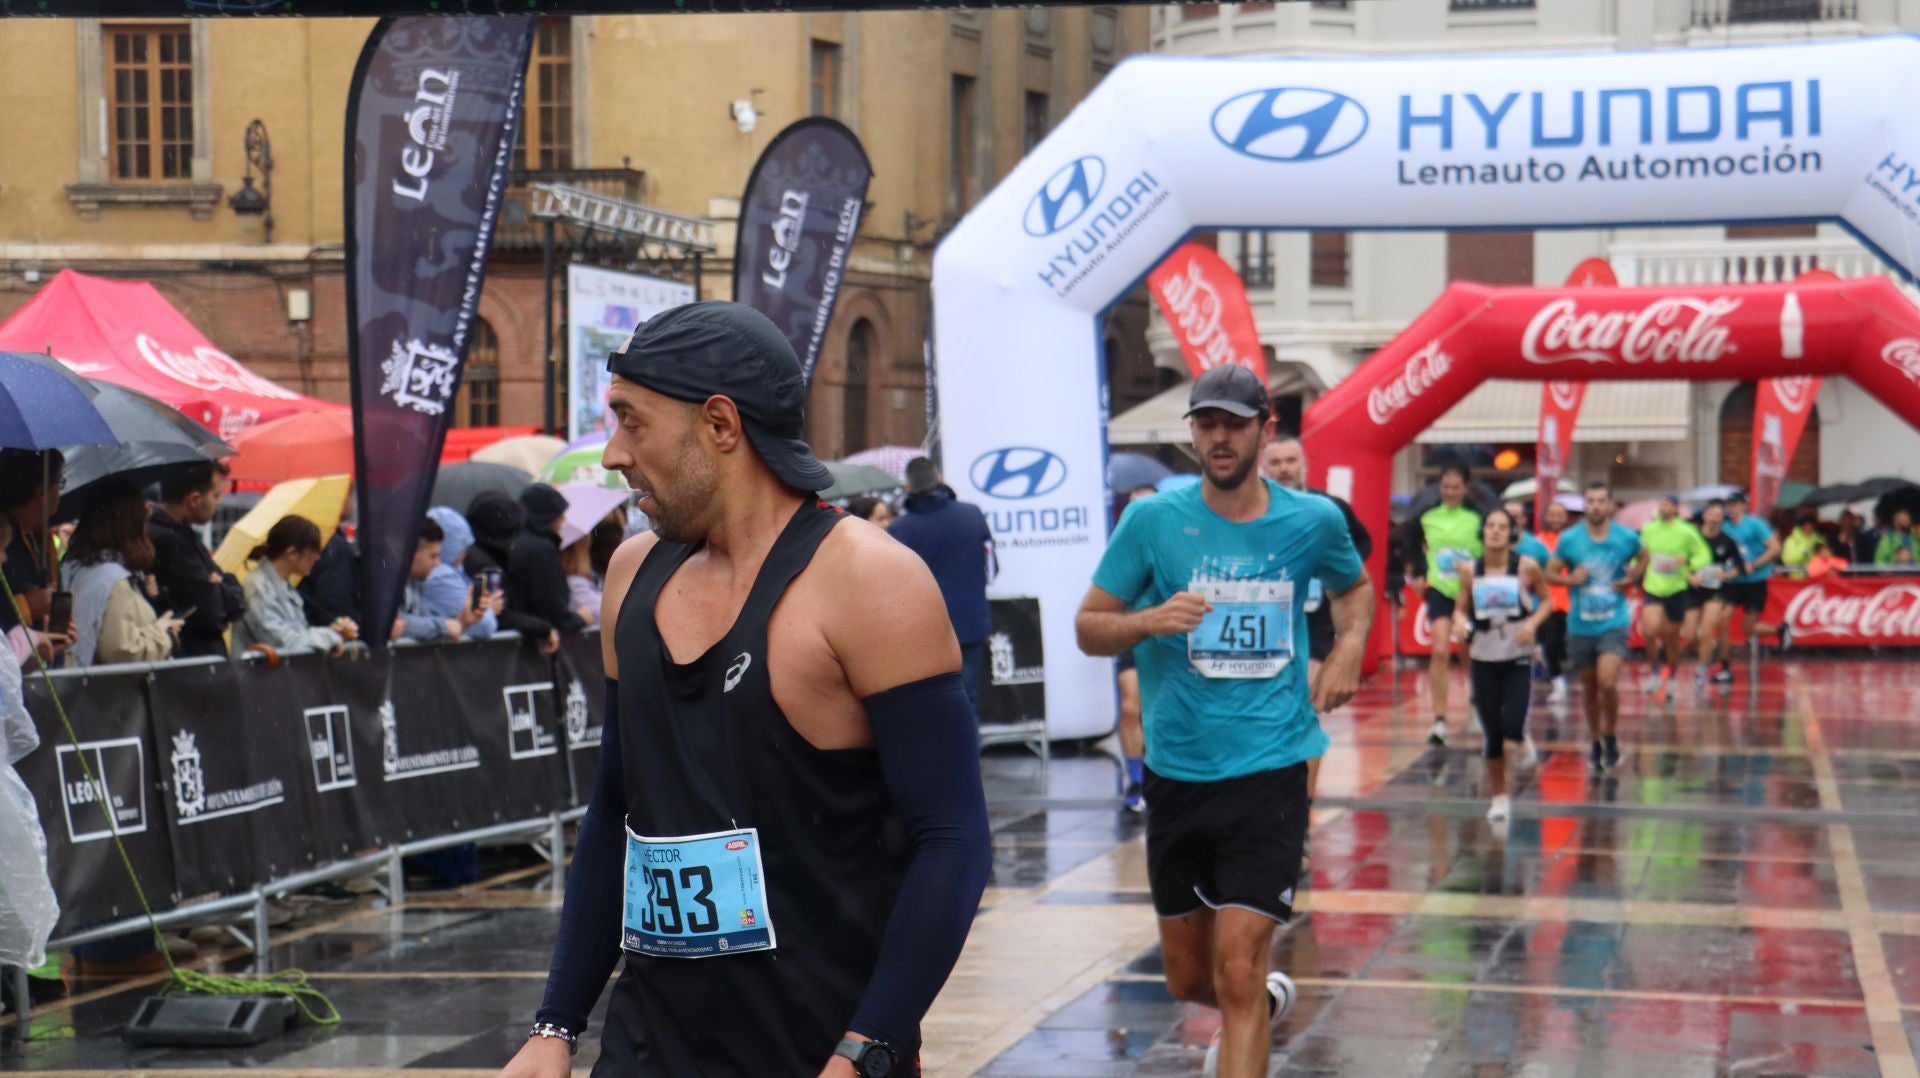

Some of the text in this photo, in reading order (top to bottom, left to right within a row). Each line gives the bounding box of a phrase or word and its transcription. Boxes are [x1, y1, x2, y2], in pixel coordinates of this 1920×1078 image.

[1399, 78, 1820, 151] HYUNDAI
[1398, 145, 1822, 185] Lemauto Automoción
[836, 197, 857, 242] LEÓN
[1037, 170, 1159, 288] HYUNDAI
[1105, 190, 1169, 252] Automoción
[829, 244, 844, 269] DE
[1521, 297, 1742, 365] Coca-Cola
[1367, 339, 1453, 425] Coca-Cola
[983, 506, 1088, 533] UNDAI
[1010, 534, 1090, 549] Automoción
[1219, 615, 1265, 649] 451
[1784, 583, 1920, 638] Coca-Col
[1229, 662, 1275, 672] HYUNDAI
[642, 865, 719, 934] 393
